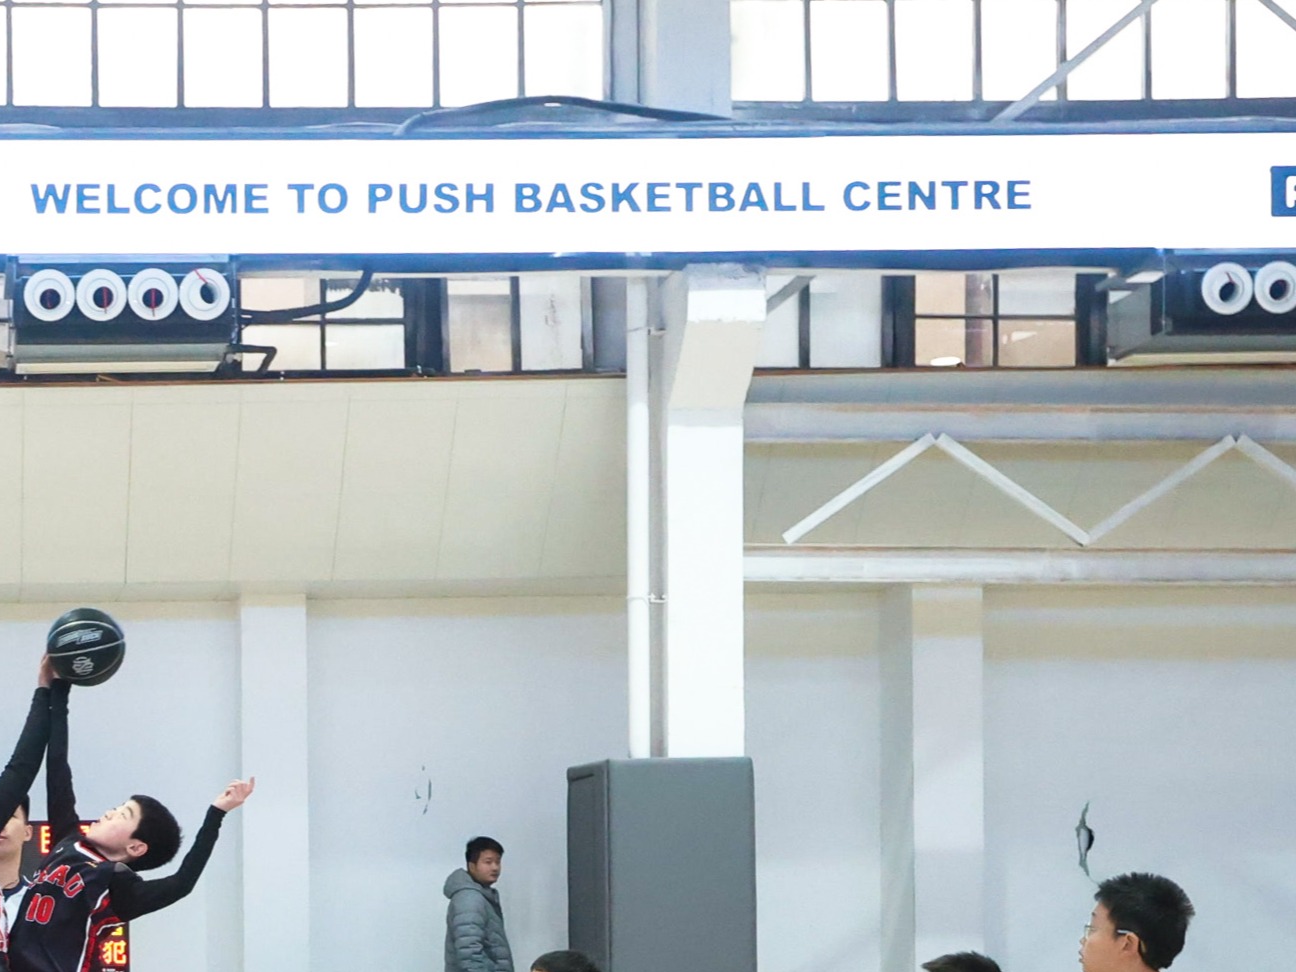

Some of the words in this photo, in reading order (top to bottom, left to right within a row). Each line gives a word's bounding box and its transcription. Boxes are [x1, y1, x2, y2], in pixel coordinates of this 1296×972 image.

[32, 183, 269, 214] WELCOME
[288, 183, 347, 213] TO
[368, 182, 494, 213] PUSH
[516, 181, 825, 213] BASKETBALL
[844, 180, 1032, 212] CENTRE
[25, 892, 55, 925] 10
